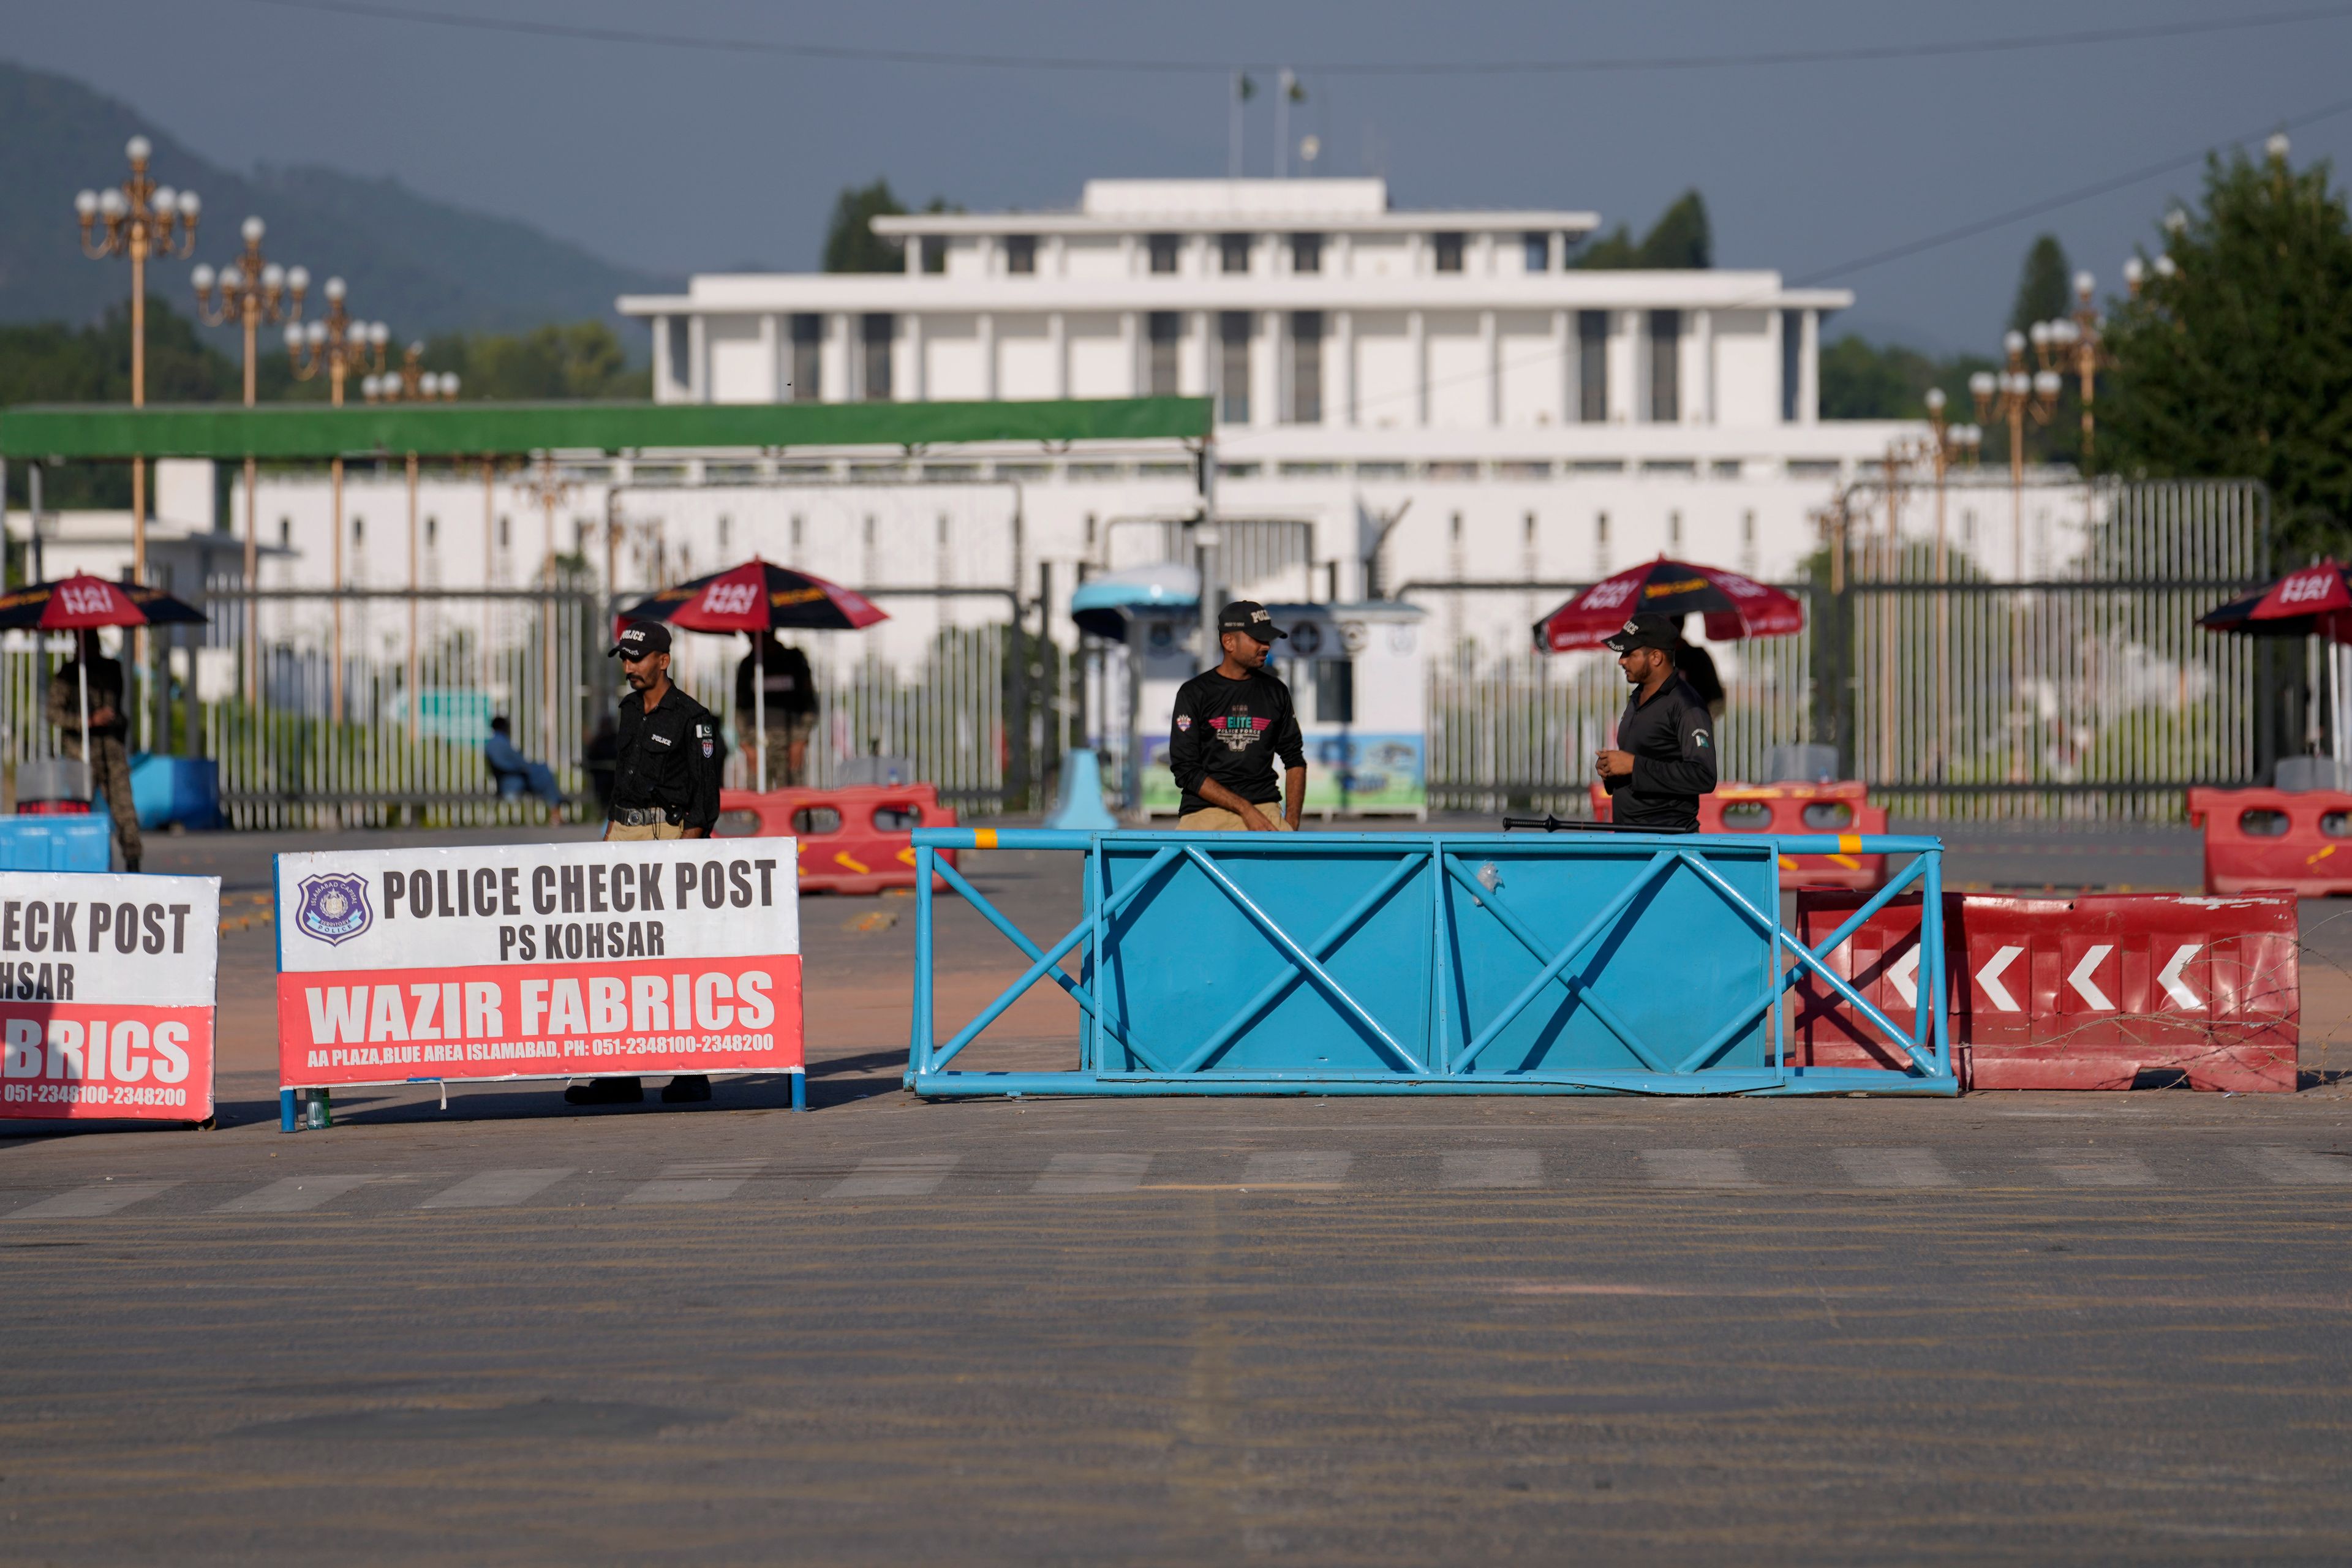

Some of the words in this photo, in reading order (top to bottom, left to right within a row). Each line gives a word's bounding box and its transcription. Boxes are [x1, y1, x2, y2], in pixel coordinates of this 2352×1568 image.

[1227, 717, 1252, 728] ELITE
[651, 734, 672, 746] POLICE
[311, 881, 339, 906] ISLAMABAD
[340, 883, 358, 905] CAPITAL
[383, 867, 521, 919] POLICE
[532, 863, 665, 915] CHECK
[675, 859, 777, 910] POST
[89, 902, 190, 955] POST
[317, 924, 353, 933] POLICE
[320, 919, 350, 927] TERRITORY
[499, 924, 537, 961] PS
[545, 921, 665, 960] KOHSAR
[305, 981, 503, 1044] WAZIR
[521, 970, 775, 1036] FABRICS
[0, 1019, 190, 1084] BRICS
[307, 1050, 330, 1068] AA
[424, 1044, 464, 1062] AREA
[466, 1040, 561, 1061] ISLAMABAD,
[564, 1039, 590, 1057] PH:
[592, 1033, 774, 1056] 051-2348100-2348200
[4, 1084, 187, 1107] 051-2348100-2348200
